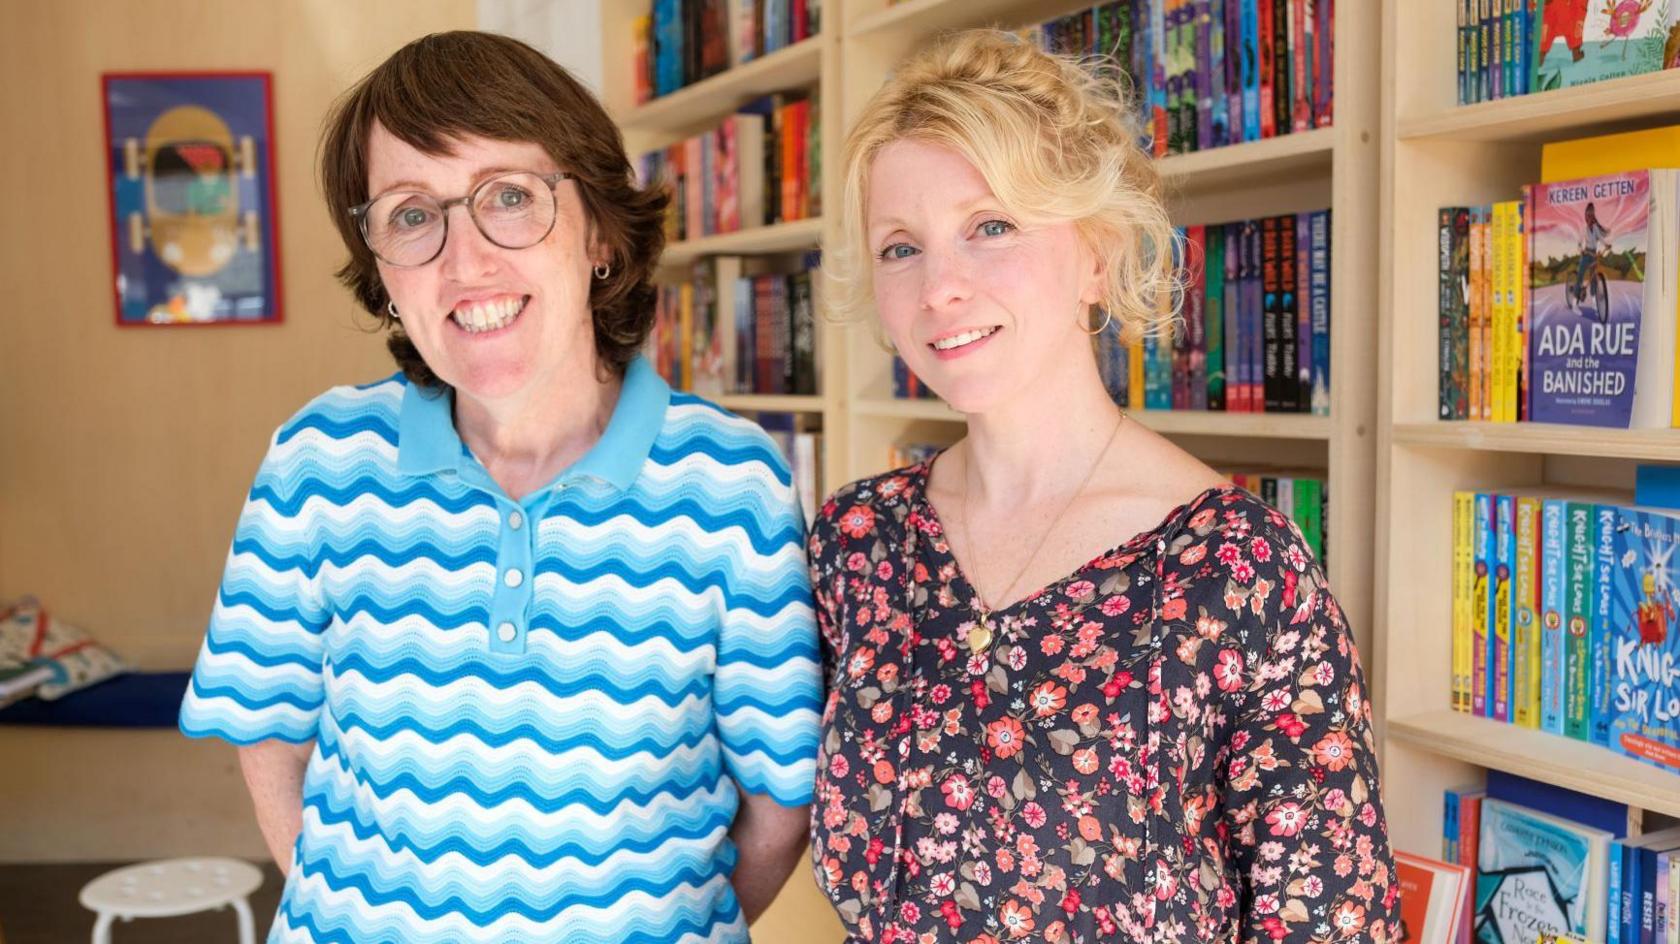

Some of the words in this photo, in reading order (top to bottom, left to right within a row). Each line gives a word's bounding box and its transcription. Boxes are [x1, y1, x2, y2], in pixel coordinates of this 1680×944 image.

[1549, 187, 1588, 203] KEREEN
[1594, 180, 1635, 199] GETTEN
[1312, 213, 1326, 248] THERE
[1312, 296, 1327, 333] CASTLE
[1538, 323, 1585, 356] ADA
[1591, 322, 1635, 355] RUE
[1566, 357, 1582, 368] and
[1585, 357, 1600, 368] the
[1543, 370, 1625, 395] BANISHED
[1546, 505, 1561, 558] KNIGHT
[1571, 510, 1588, 563] KNIGHT
[1599, 510, 1615, 565] KNIGHT
[1615, 682, 1648, 723] SIR
[1500, 891, 1559, 935] Frozen
[1643, 891, 1654, 932] RESIST
